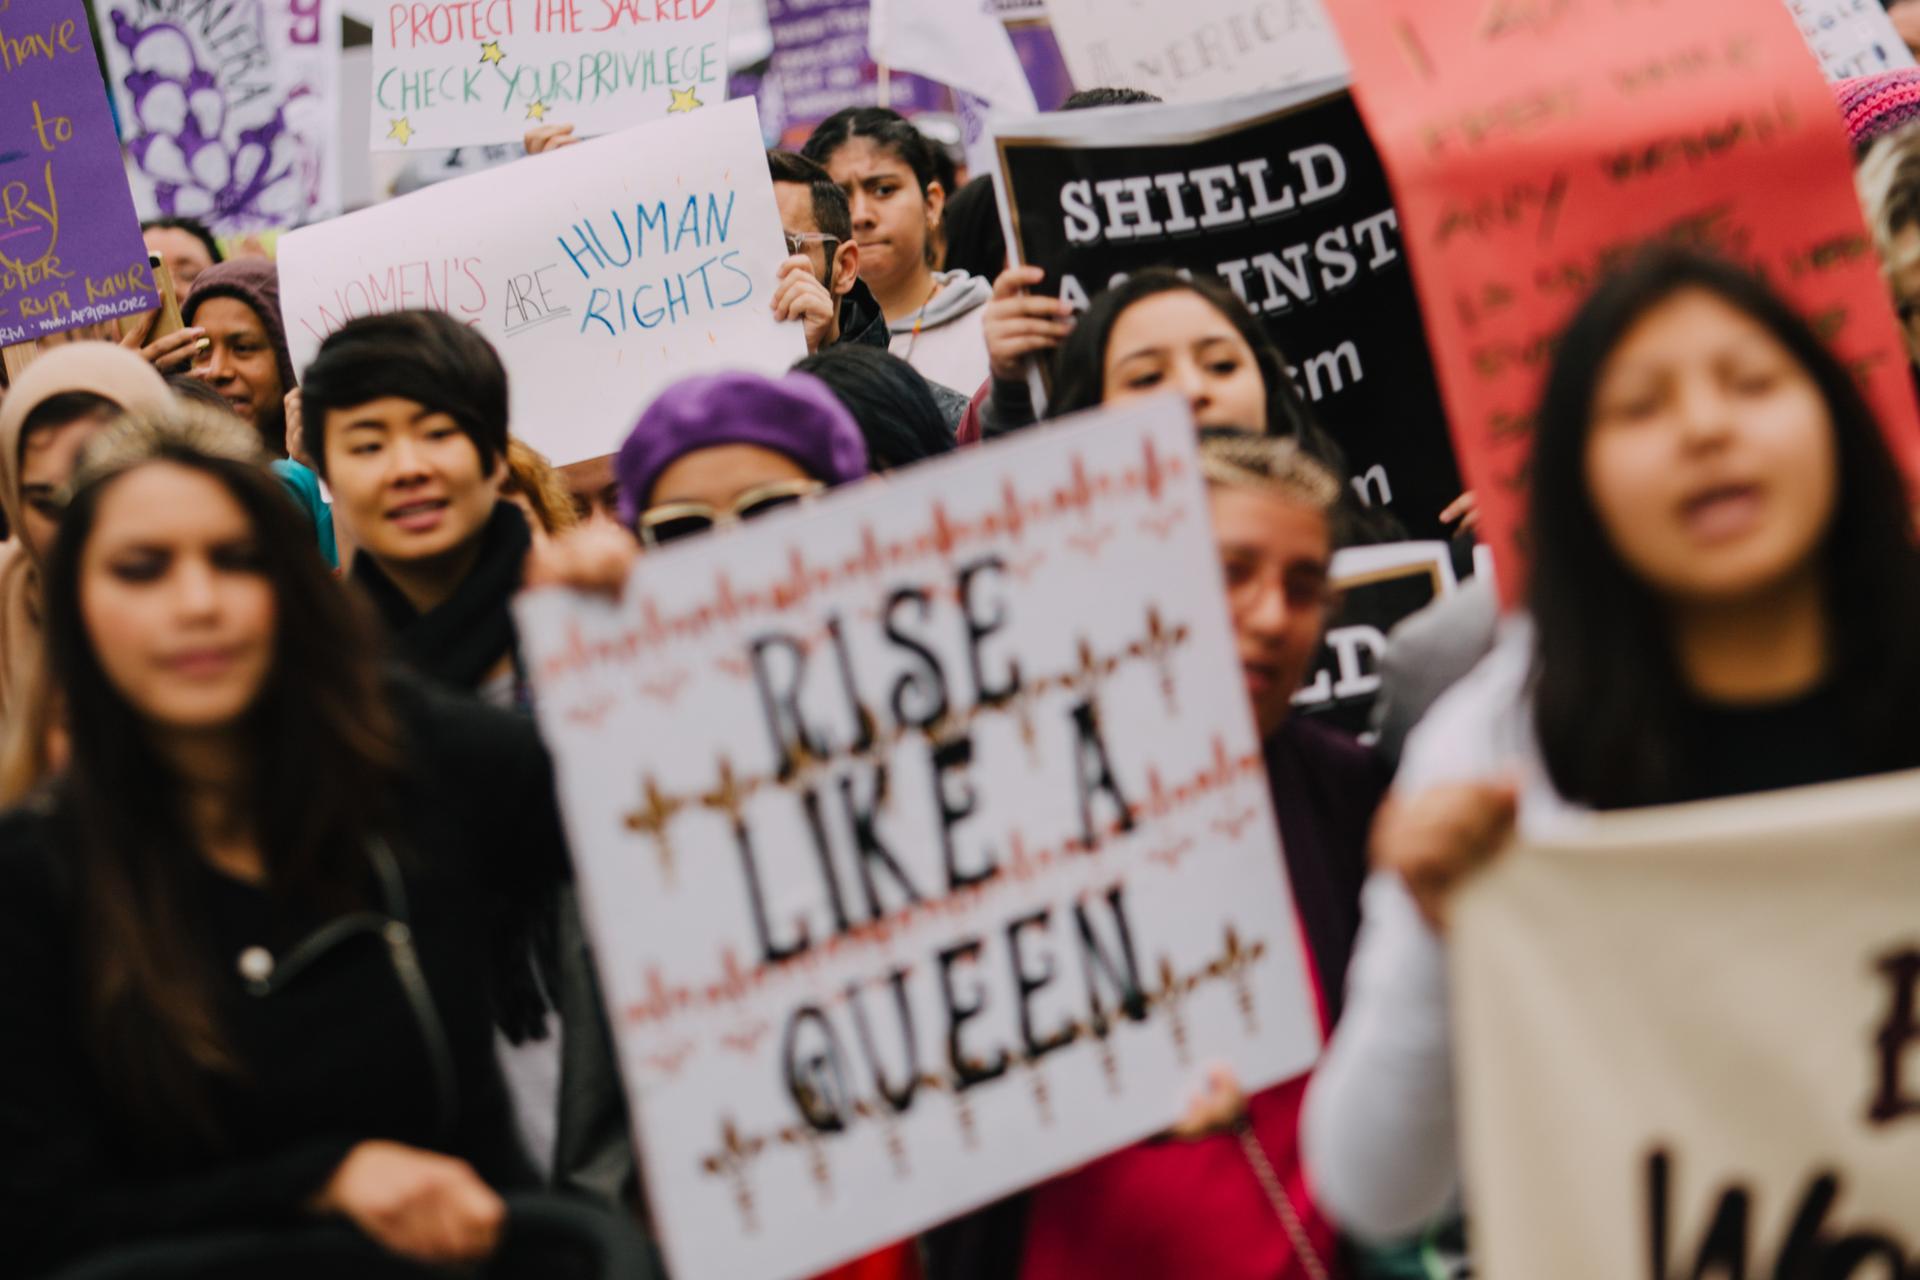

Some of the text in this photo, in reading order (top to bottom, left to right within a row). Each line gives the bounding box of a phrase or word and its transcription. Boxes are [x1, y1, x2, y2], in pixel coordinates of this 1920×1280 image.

[0, 18, 84, 74] have
[389, 0, 514, 48] PROTECT
[32, 100, 73, 151] to
[377, 43, 718, 112] CHECK YOUR PRIVILEGE
[1059, 143, 1348, 243] SHIELD
[300, 190, 736, 343] WOMEN'S ARE HUMAN
[580, 250, 753, 336] RIGHTS
[1058, 208, 1398, 316] AINST
[750, 555, 1021, 773] RISE
[736, 702, 1137, 966] LIKE A
[783, 884, 1151, 1133] QUEEN
